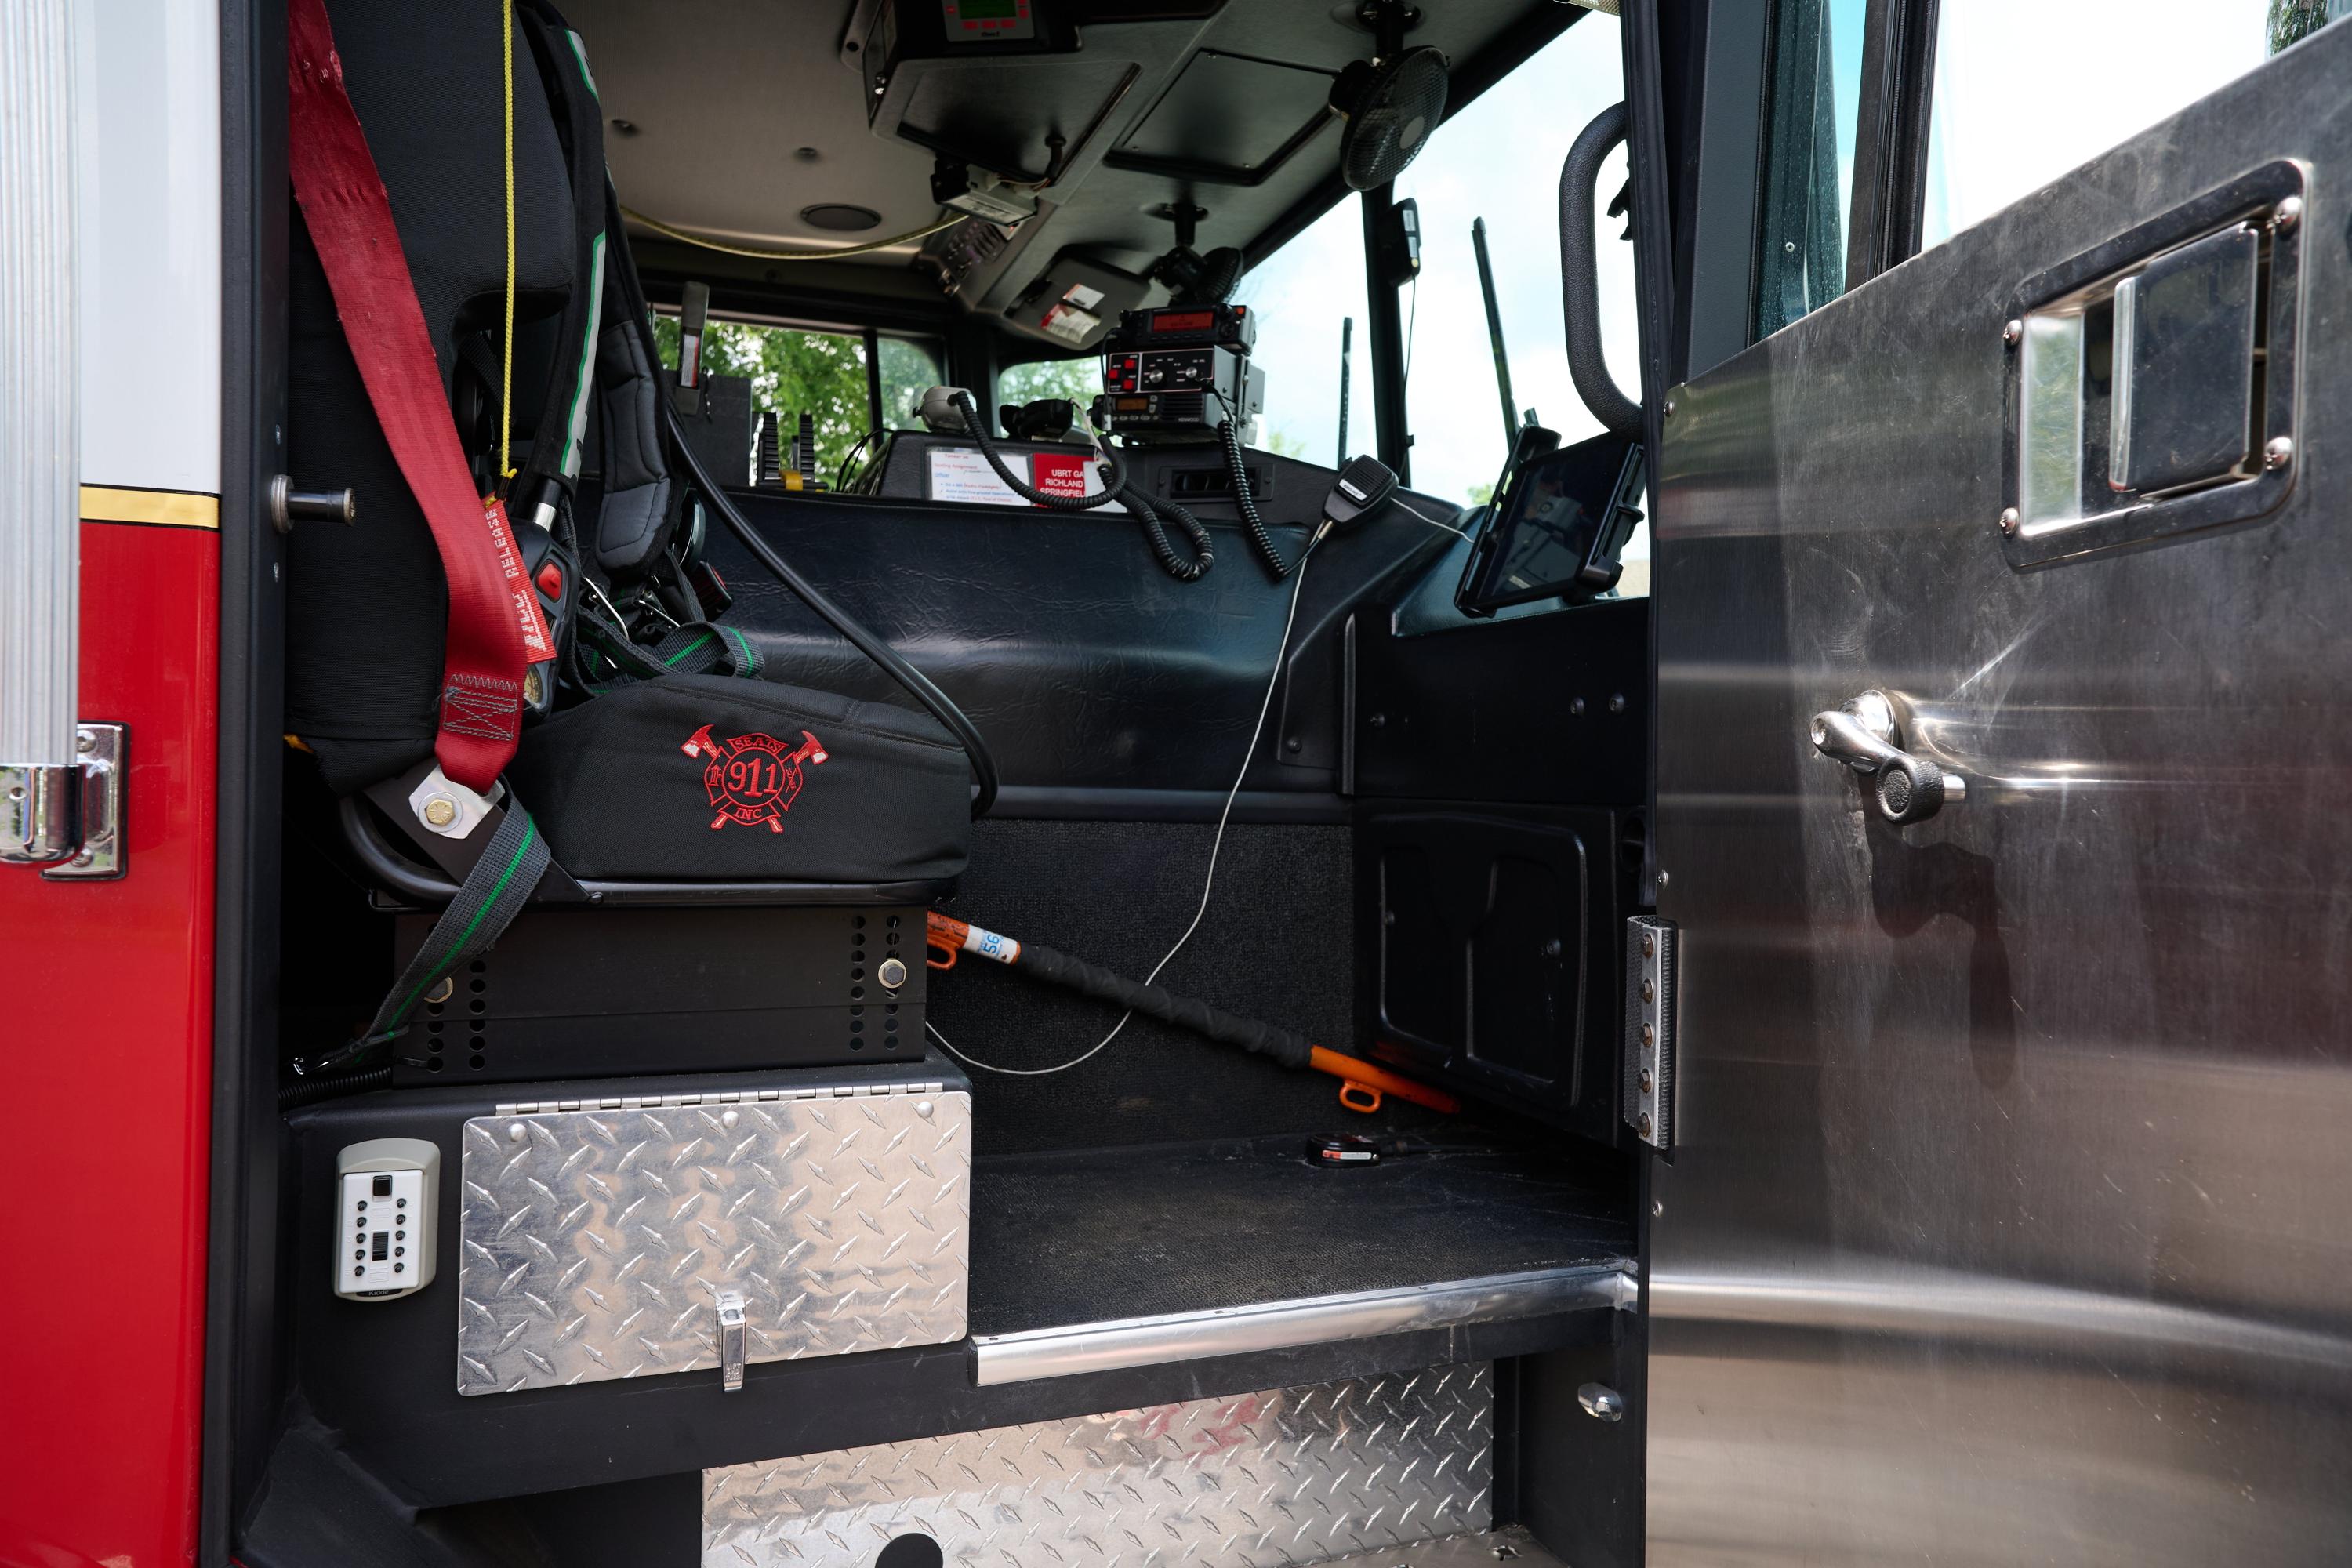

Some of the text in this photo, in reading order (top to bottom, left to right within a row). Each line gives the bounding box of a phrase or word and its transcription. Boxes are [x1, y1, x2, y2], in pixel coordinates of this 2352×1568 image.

[1051, 469, 1072, 478] UBRT
[1045, 477, 1084, 488] RICHLAND
[485, 509, 519, 578] RELEASE
[734, 735, 782, 752] SEATS
[727, 757, 778, 797] 911
[734, 807, 762, 821] INC
[982, 934, 1000, 954] 56
